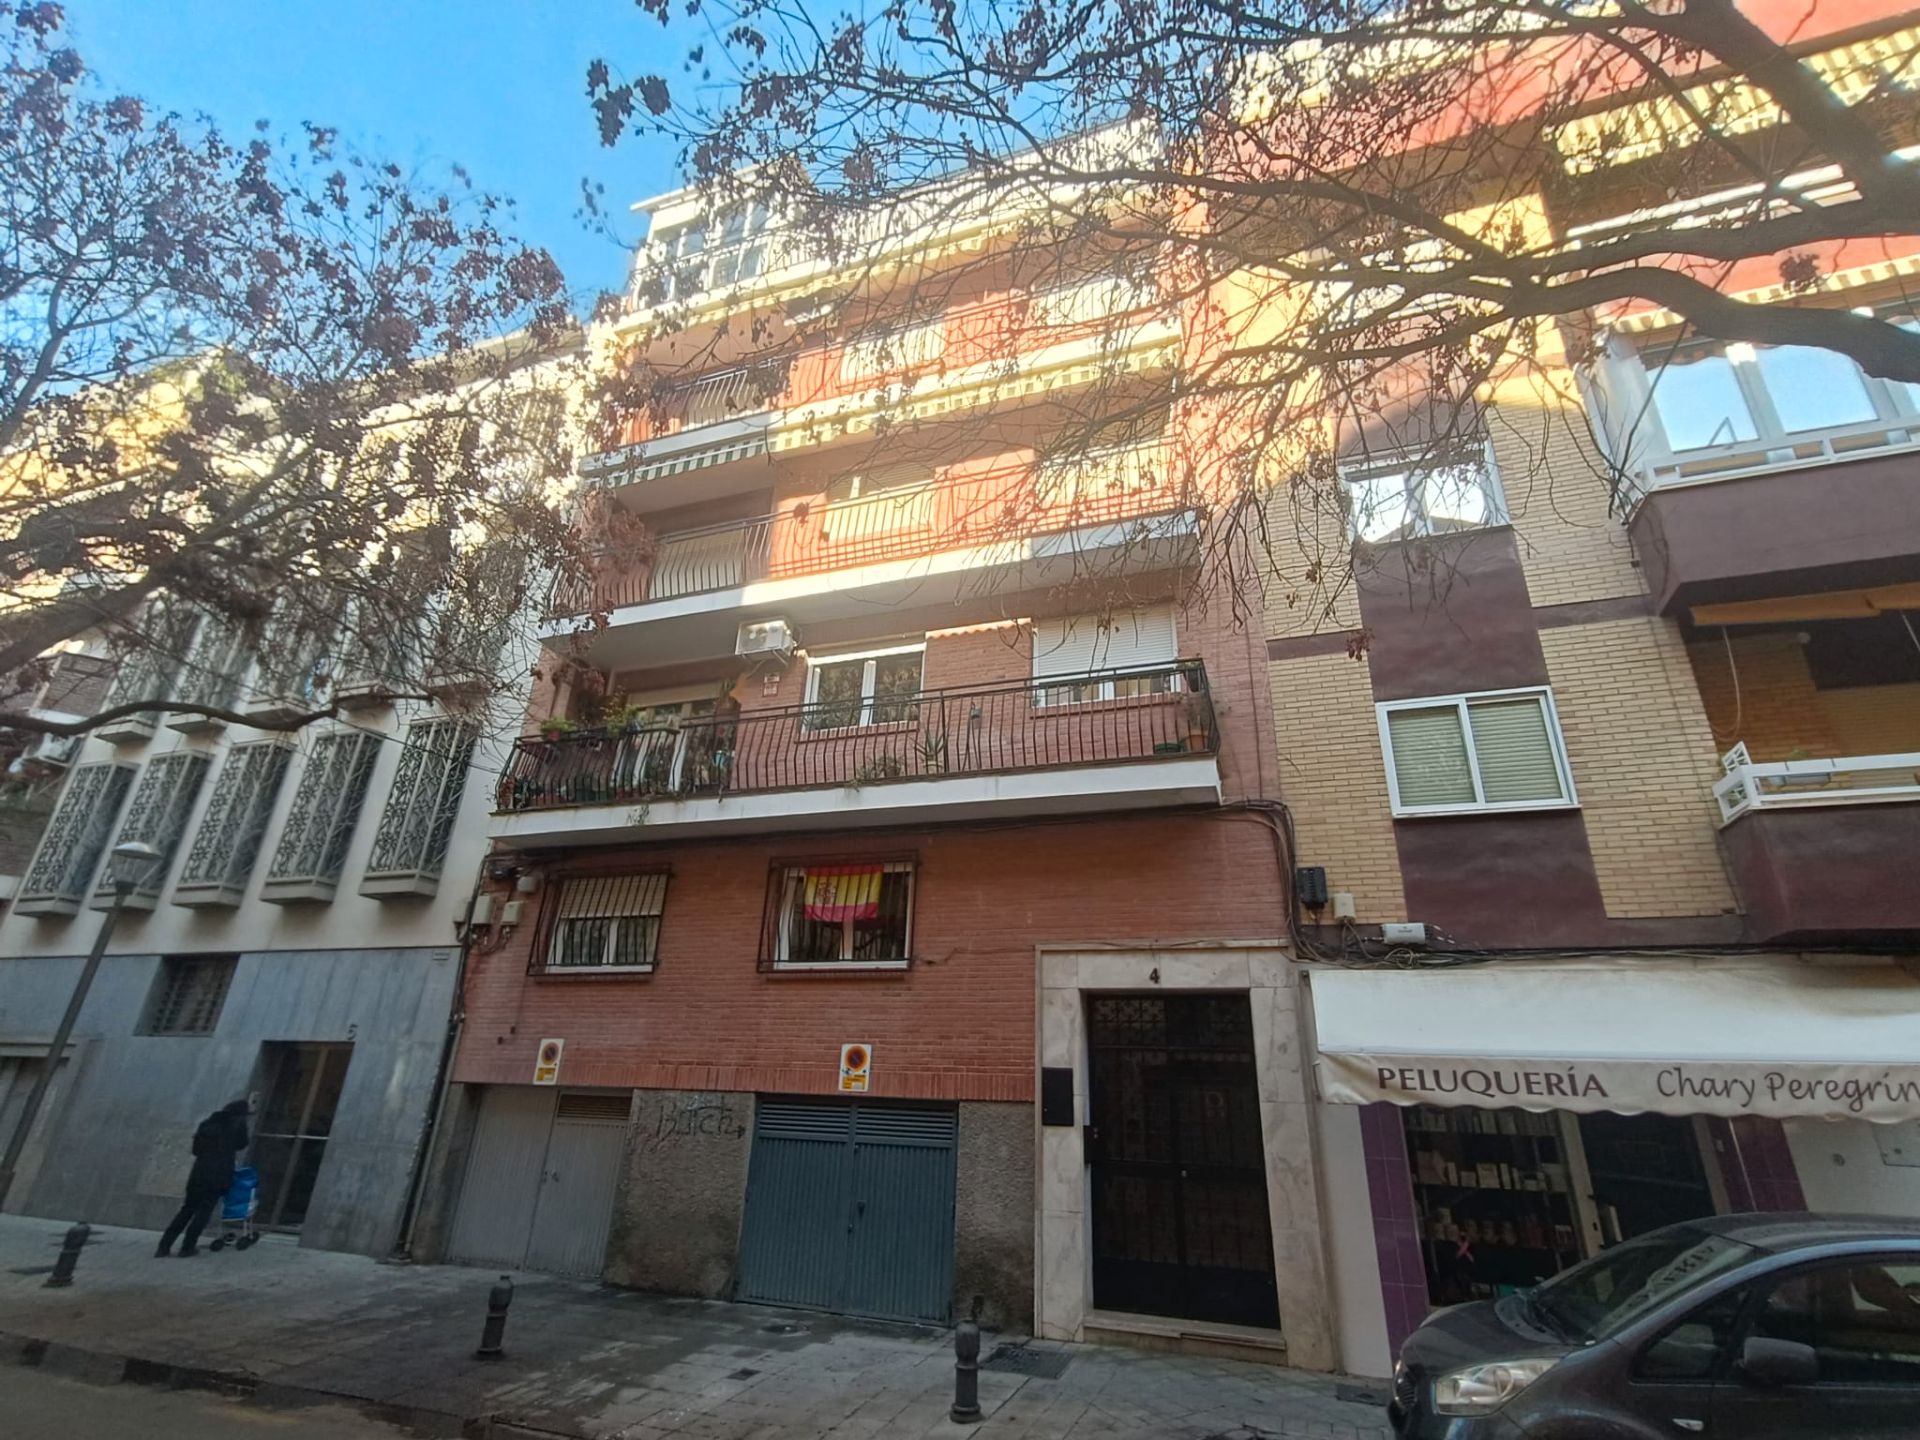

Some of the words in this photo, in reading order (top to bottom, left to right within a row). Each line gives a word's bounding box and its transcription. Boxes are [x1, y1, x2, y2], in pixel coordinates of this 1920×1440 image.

[1149, 967, 1160, 985] 4
[1377, 1066, 1609, 1098] PELUQUERÍA
[1656, 1067, 1755, 1107] Chary
